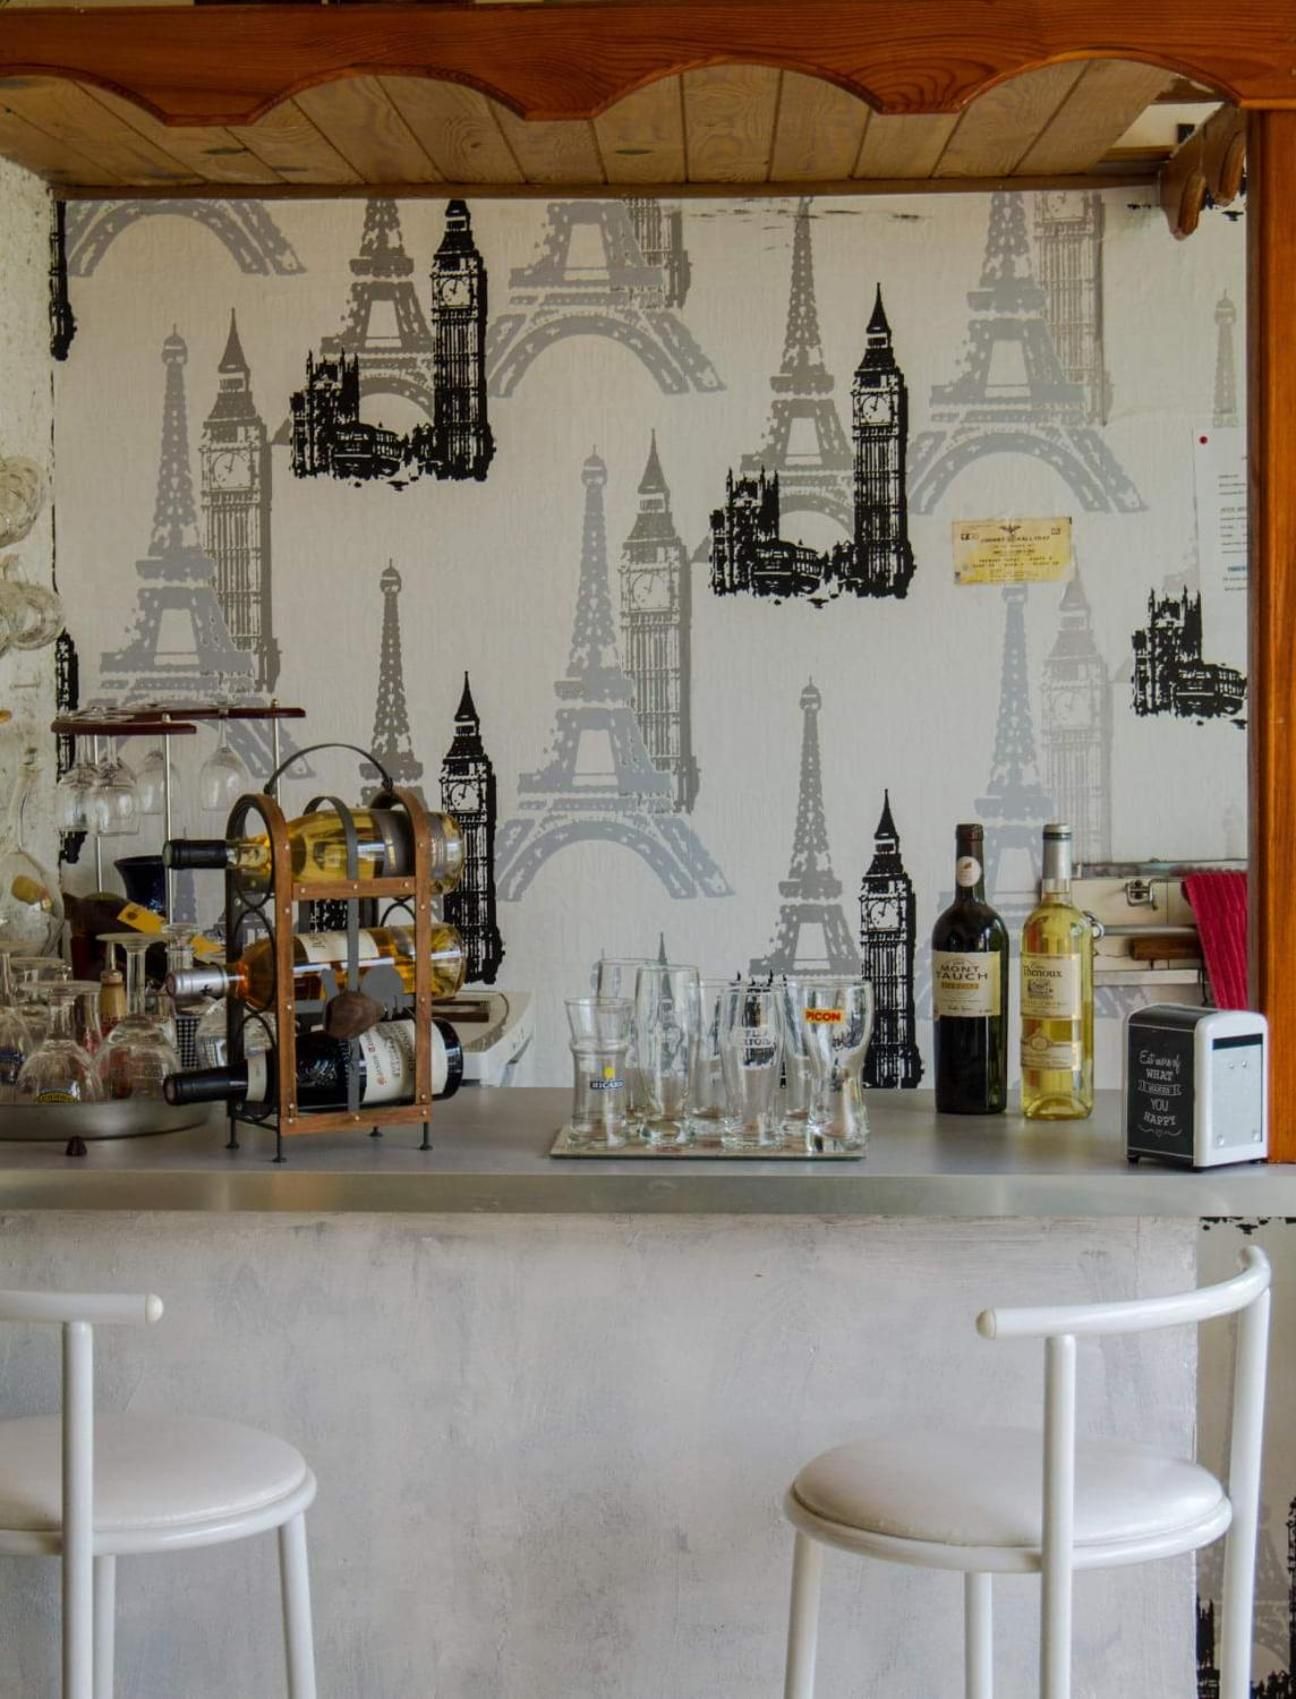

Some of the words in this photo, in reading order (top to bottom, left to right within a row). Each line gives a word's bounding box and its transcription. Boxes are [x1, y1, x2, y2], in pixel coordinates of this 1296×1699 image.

[940, 964, 979, 972] MONT
[936, 970, 988, 981] TAUCH
[805, 1010, 841, 1021] PICON
[1146, 1068, 1173, 1081] WHAT
[1151, 1098, 1169, 1112] YOU
[1143, 1111, 1177, 1126] HAPPY
